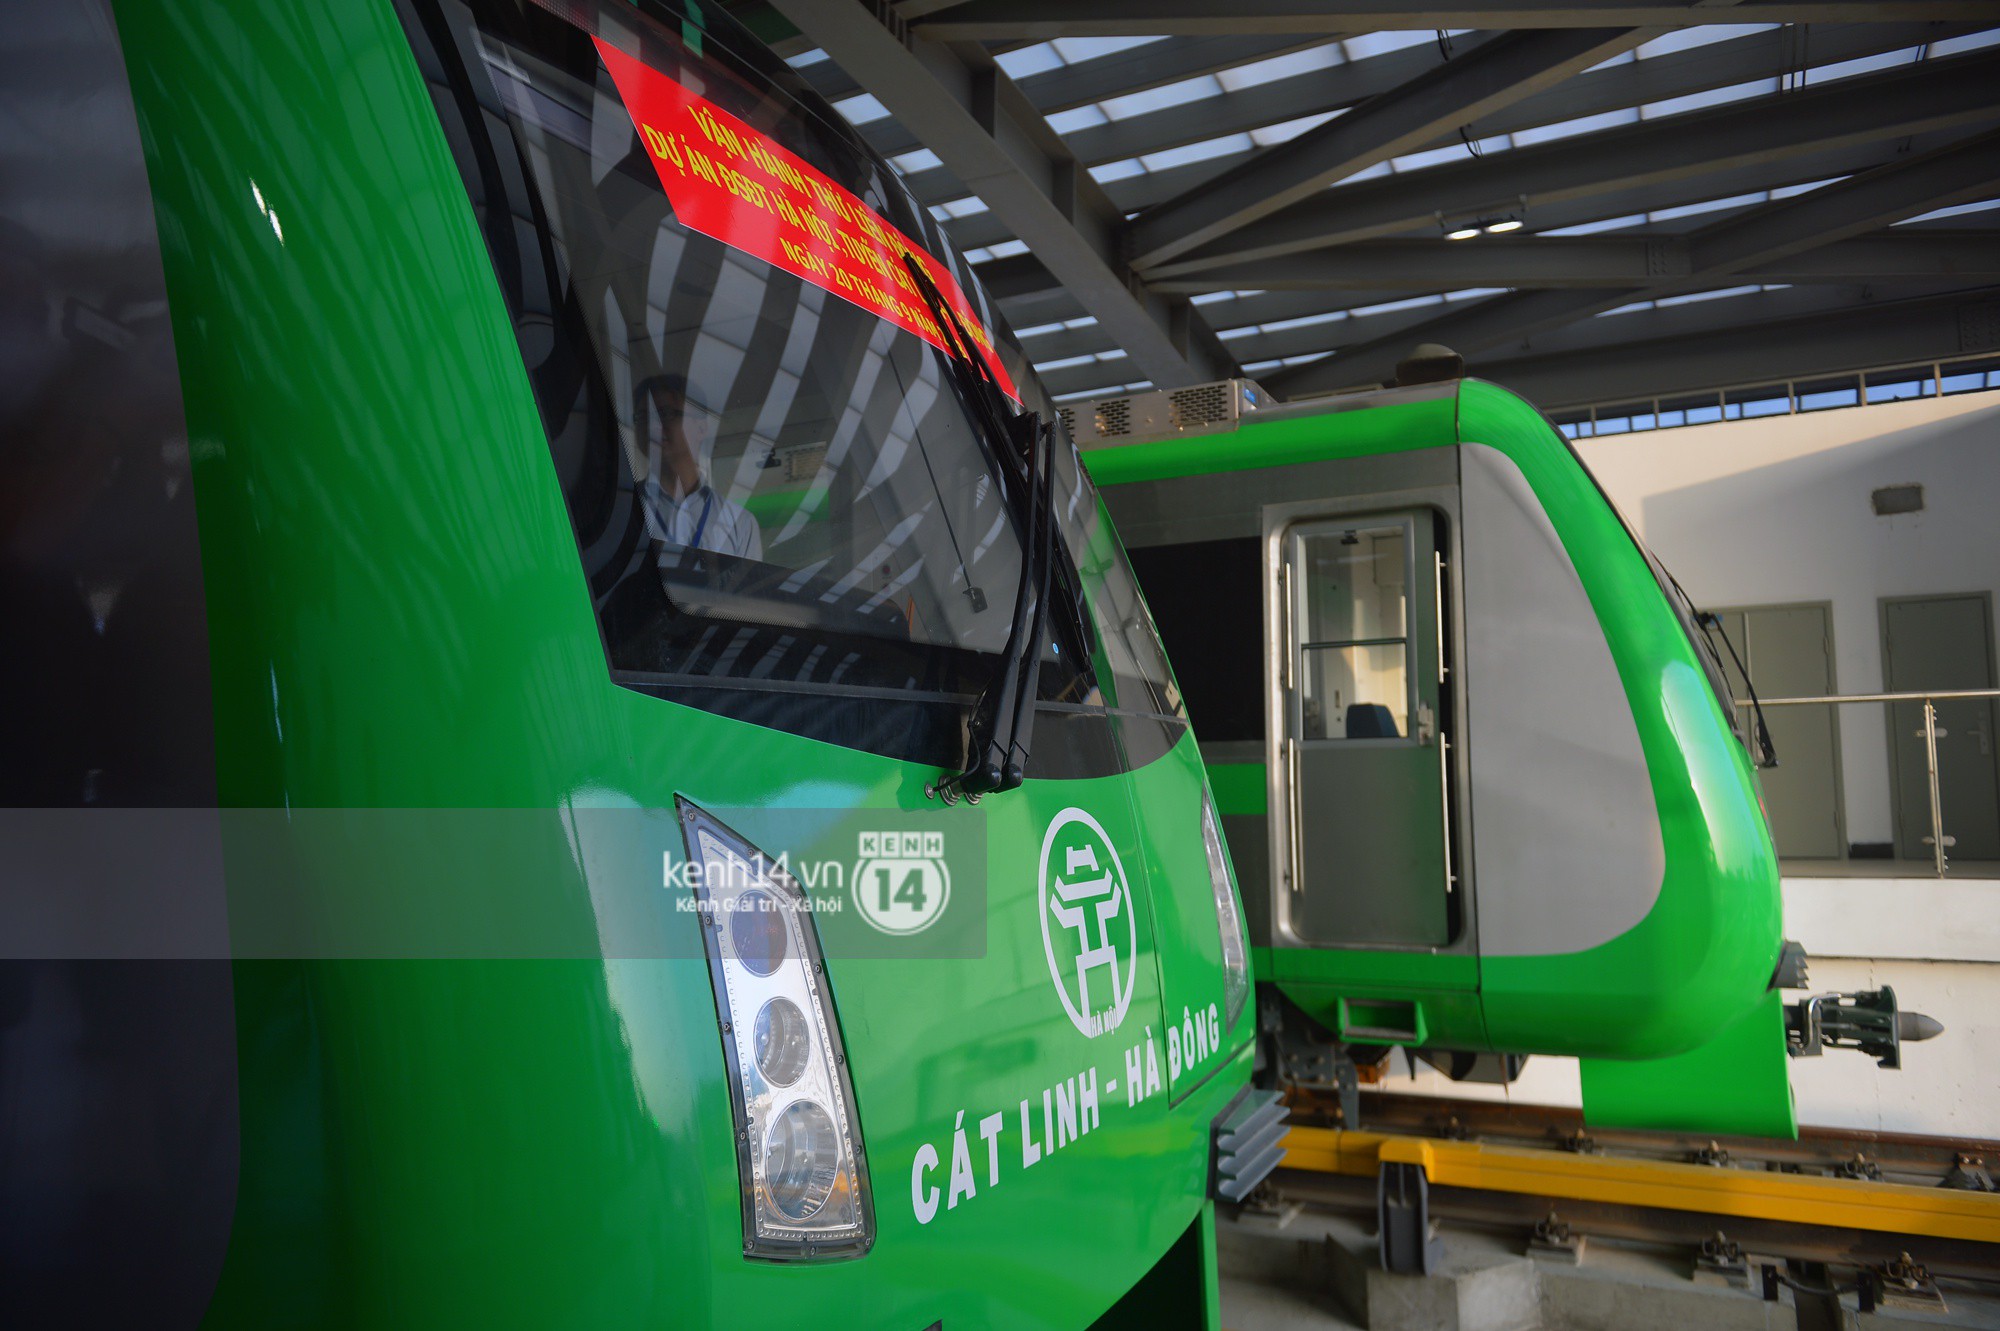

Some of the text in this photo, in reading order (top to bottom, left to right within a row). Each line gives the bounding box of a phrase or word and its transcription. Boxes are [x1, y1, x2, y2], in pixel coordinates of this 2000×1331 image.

[687, 105, 748, 161] VẬN
[743, 137, 812, 198] HÀNH
[642, 122, 686, 177] DỰ
[680, 134, 722, 188] ÁN
[715, 161, 775, 215] ĐSĐT
[770, 188, 807, 232] HÀ
[886, 256, 918, 298] CÁT
[779, 237, 831, 280] NGÀY
[829, 262, 853, 291] 20
[848, 272, 904, 318] THÁNG
[901, 302, 914, 323] 9
[910, 308, 942, 340] NĂM
[1090, 1004, 1118, 1038] HÀ NỘI
[911, 1003, 1220, 1225] CÁT LINH - HÀ ĐÔNG
